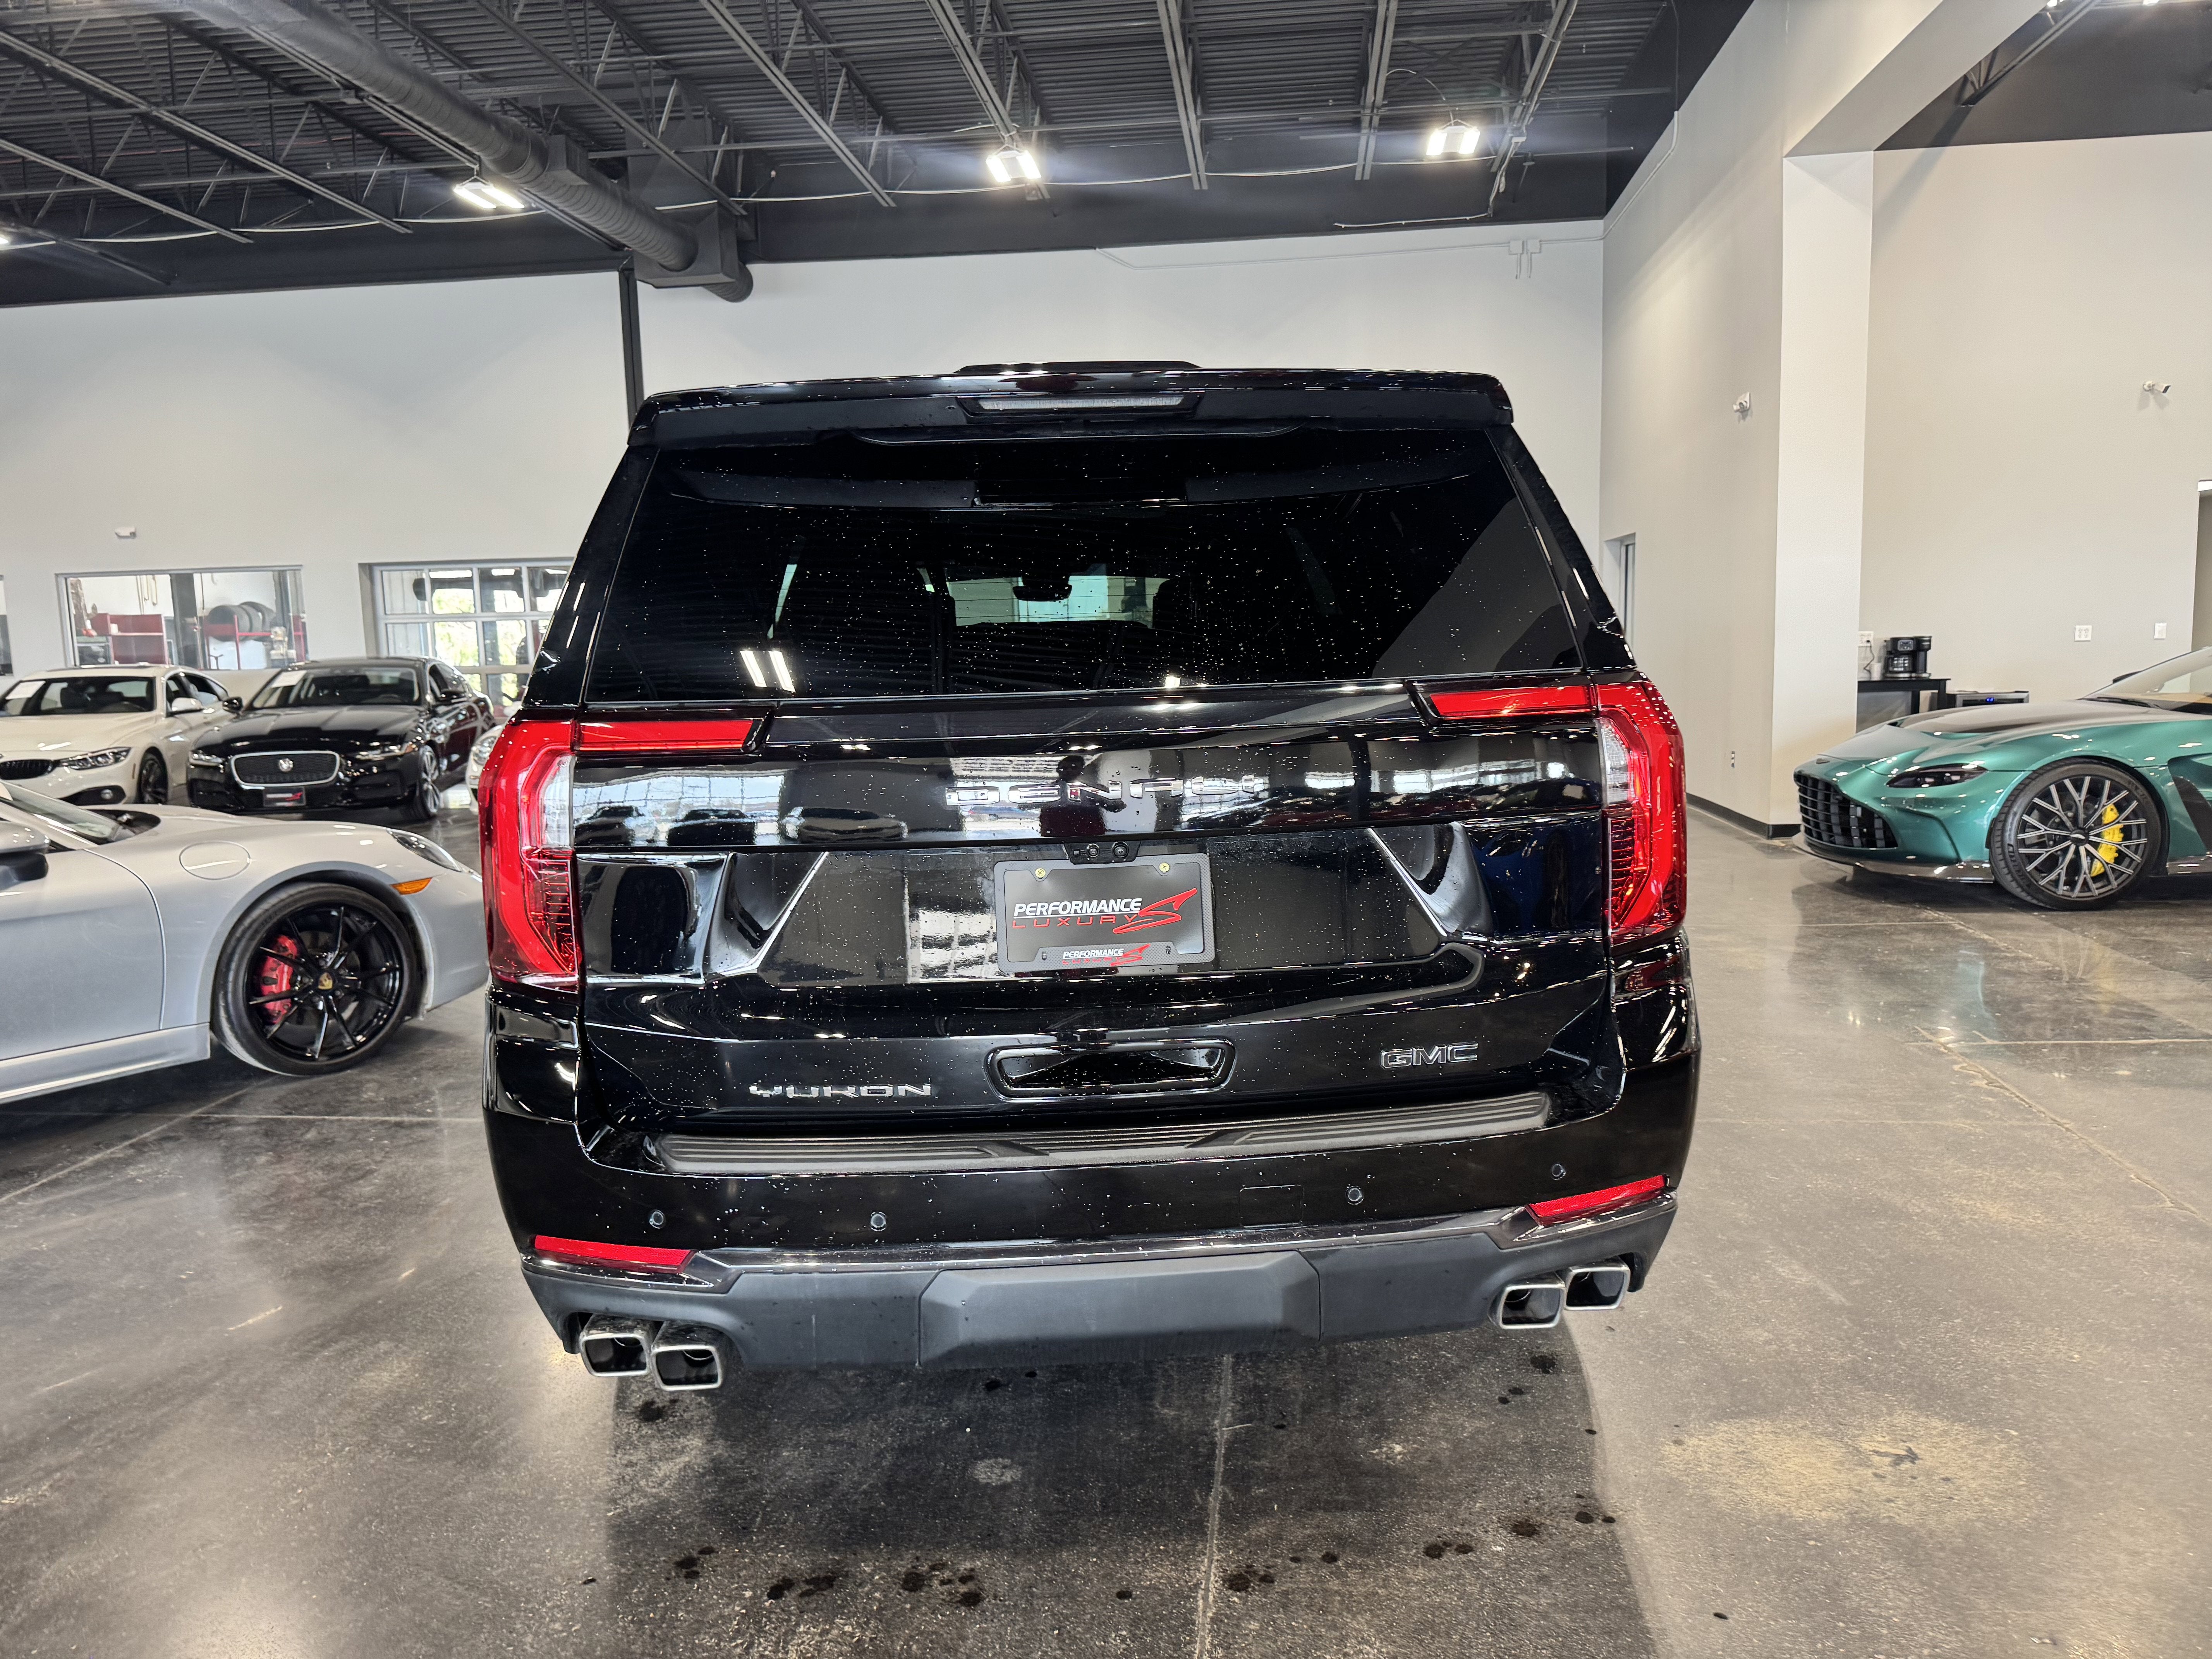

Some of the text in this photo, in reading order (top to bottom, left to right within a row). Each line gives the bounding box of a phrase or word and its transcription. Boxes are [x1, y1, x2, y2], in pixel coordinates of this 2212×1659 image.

[1013, 898, 1142, 916] PERFORMANCE
[1012, 914, 1138, 928] LUXURY
[1063, 948, 1124, 958] PERFORMANCE
[1381, 1042, 1478, 1068] GMC
[749, 1084, 931, 1098] YUKON
